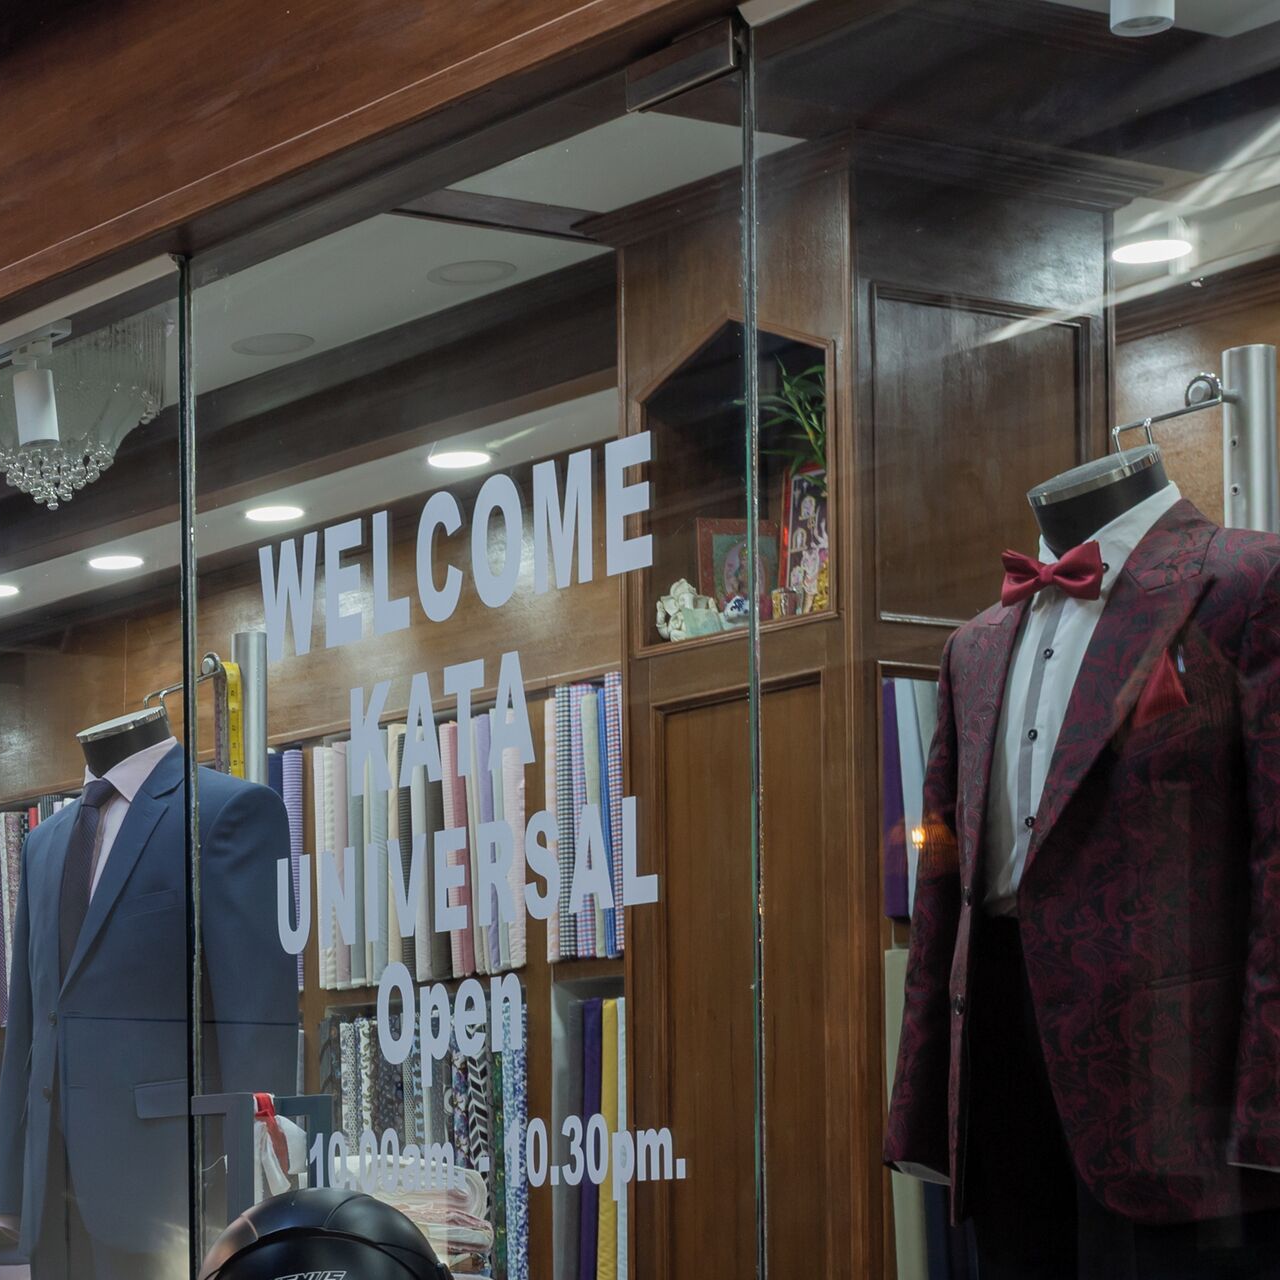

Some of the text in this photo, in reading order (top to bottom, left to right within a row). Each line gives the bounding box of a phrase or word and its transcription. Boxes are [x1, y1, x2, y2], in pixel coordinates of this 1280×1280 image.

[258, 430, 654, 664] WELCOME
[351, 651, 536, 796] KATA
[276, 797, 659, 954] UNIVERSAL
[377, 962, 523, 1088] Open
